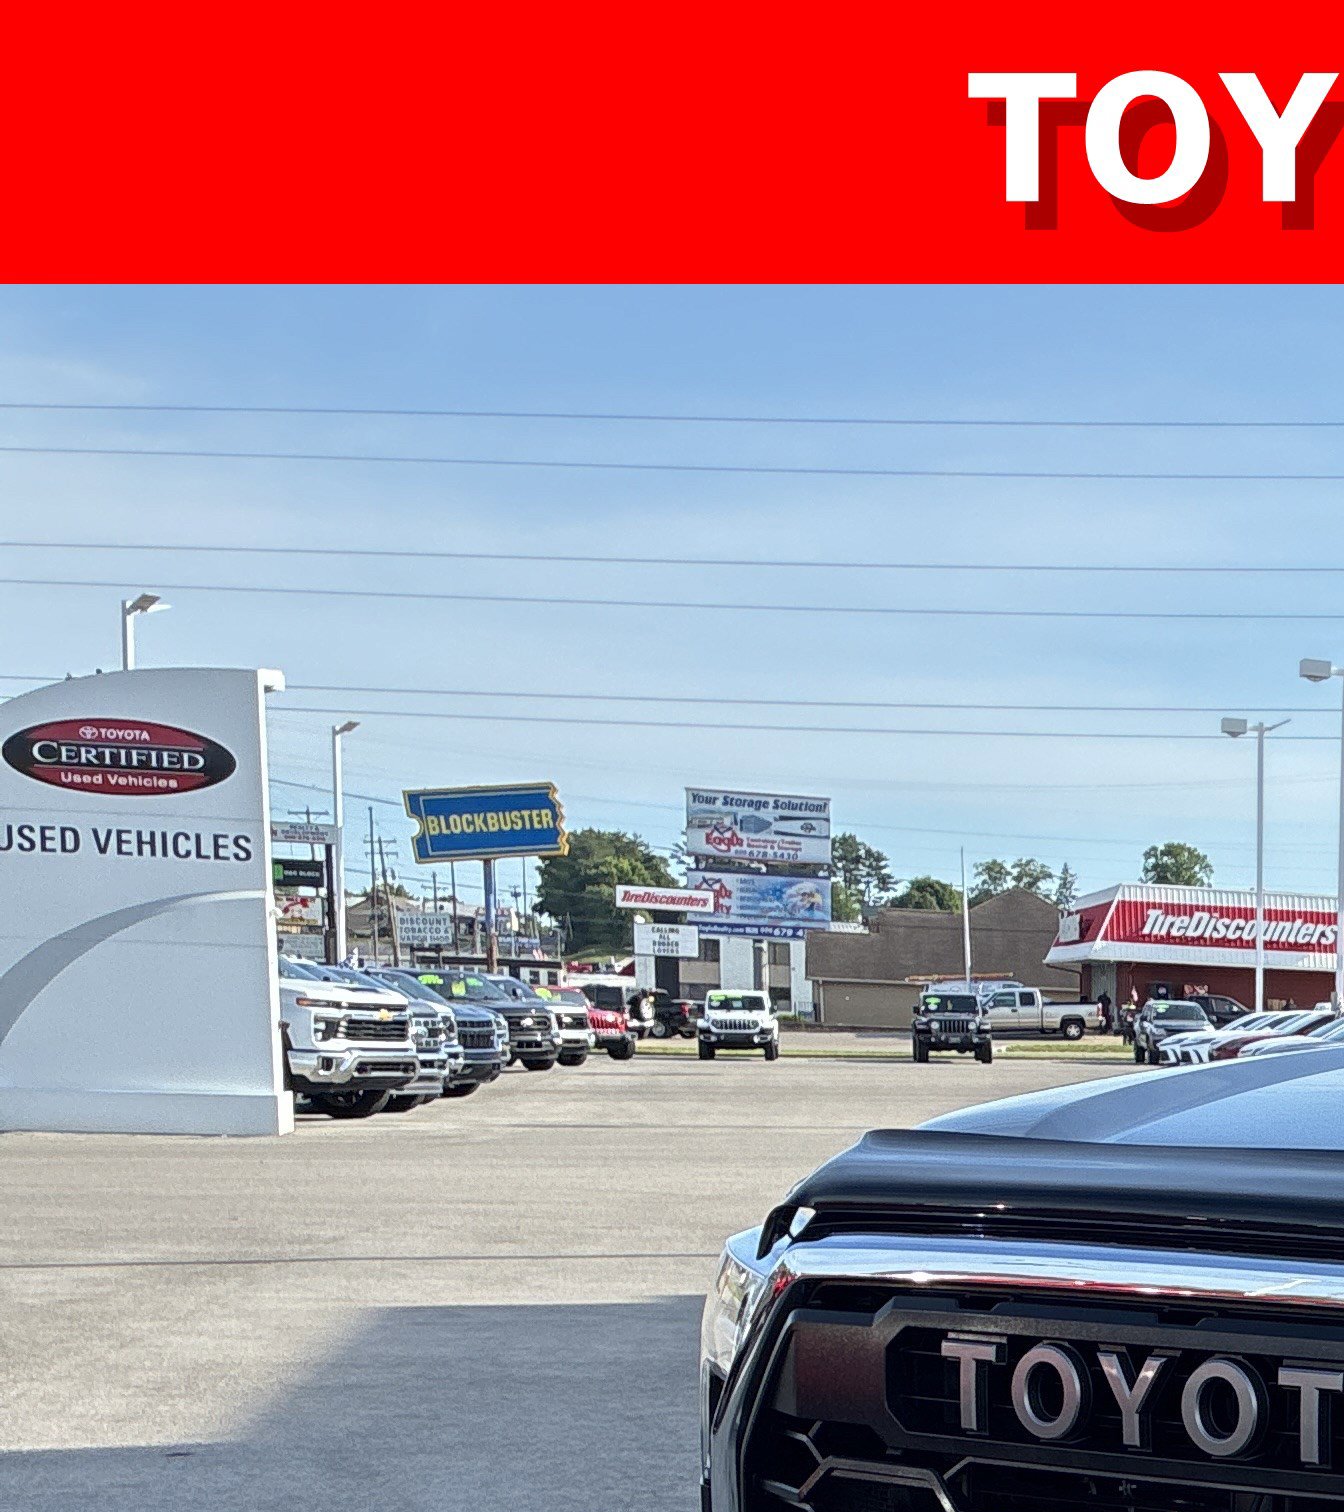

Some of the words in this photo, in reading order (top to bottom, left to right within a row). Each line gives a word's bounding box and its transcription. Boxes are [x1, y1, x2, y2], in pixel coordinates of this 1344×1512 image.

[100, 728, 150, 741] TOYOTA
[32, 741, 205, 769] CERTIFIED
[60, 771, 103, 783] Used
[107, 774, 178, 788] Vehicles
[691, 793, 719, 805] Your
[722, 796, 770, 810] Storage
[426, 809, 554, 836] BLOCKBUSTER
[0, 824, 80, 853] USED
[92, 828, 252, 862] VEHICLES
[622, 890, 709, 908] TireDiscounters
[1142, 908, 1337, 945] TireDiscounters
